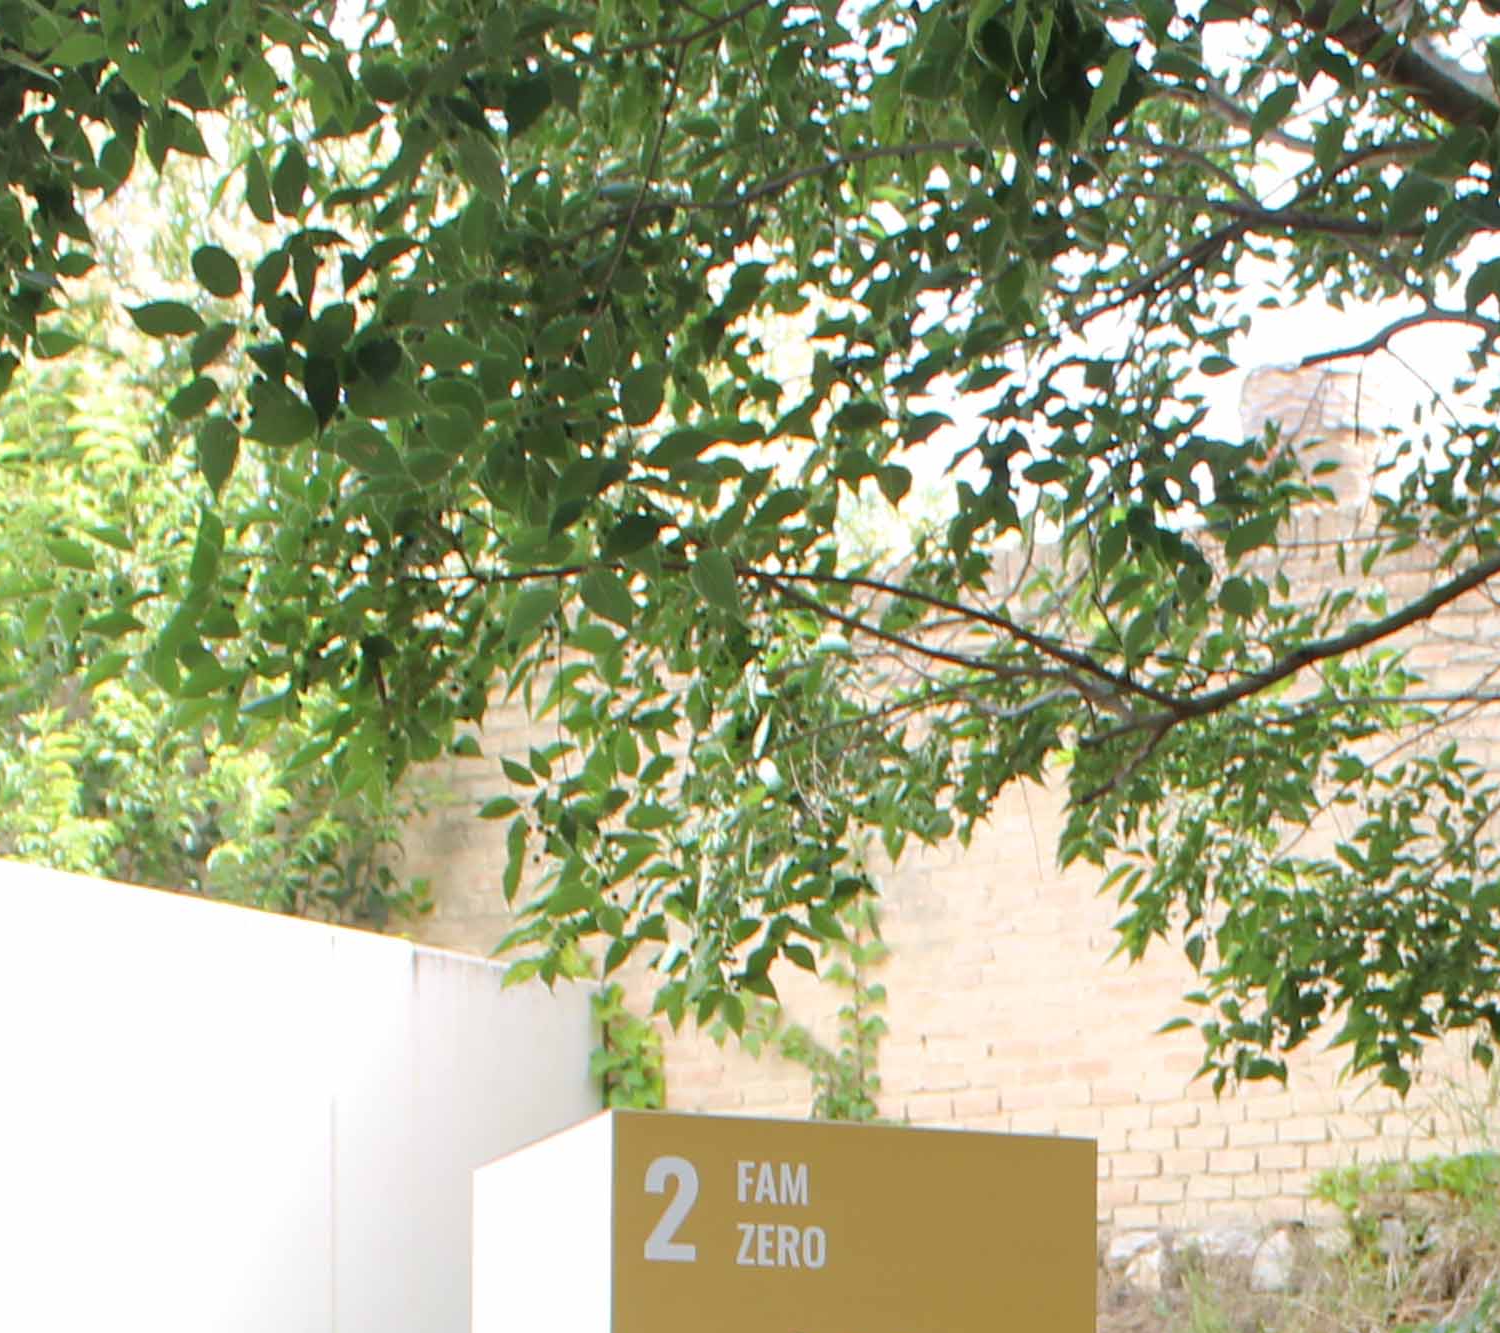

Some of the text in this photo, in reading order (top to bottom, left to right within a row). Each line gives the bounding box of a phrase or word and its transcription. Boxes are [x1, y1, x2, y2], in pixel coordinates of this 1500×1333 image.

[737, 1160, 808, 1205] FAM
[644, 1155, 699, 1262] 2
[736, 1223, 826, 1268] ZERO
